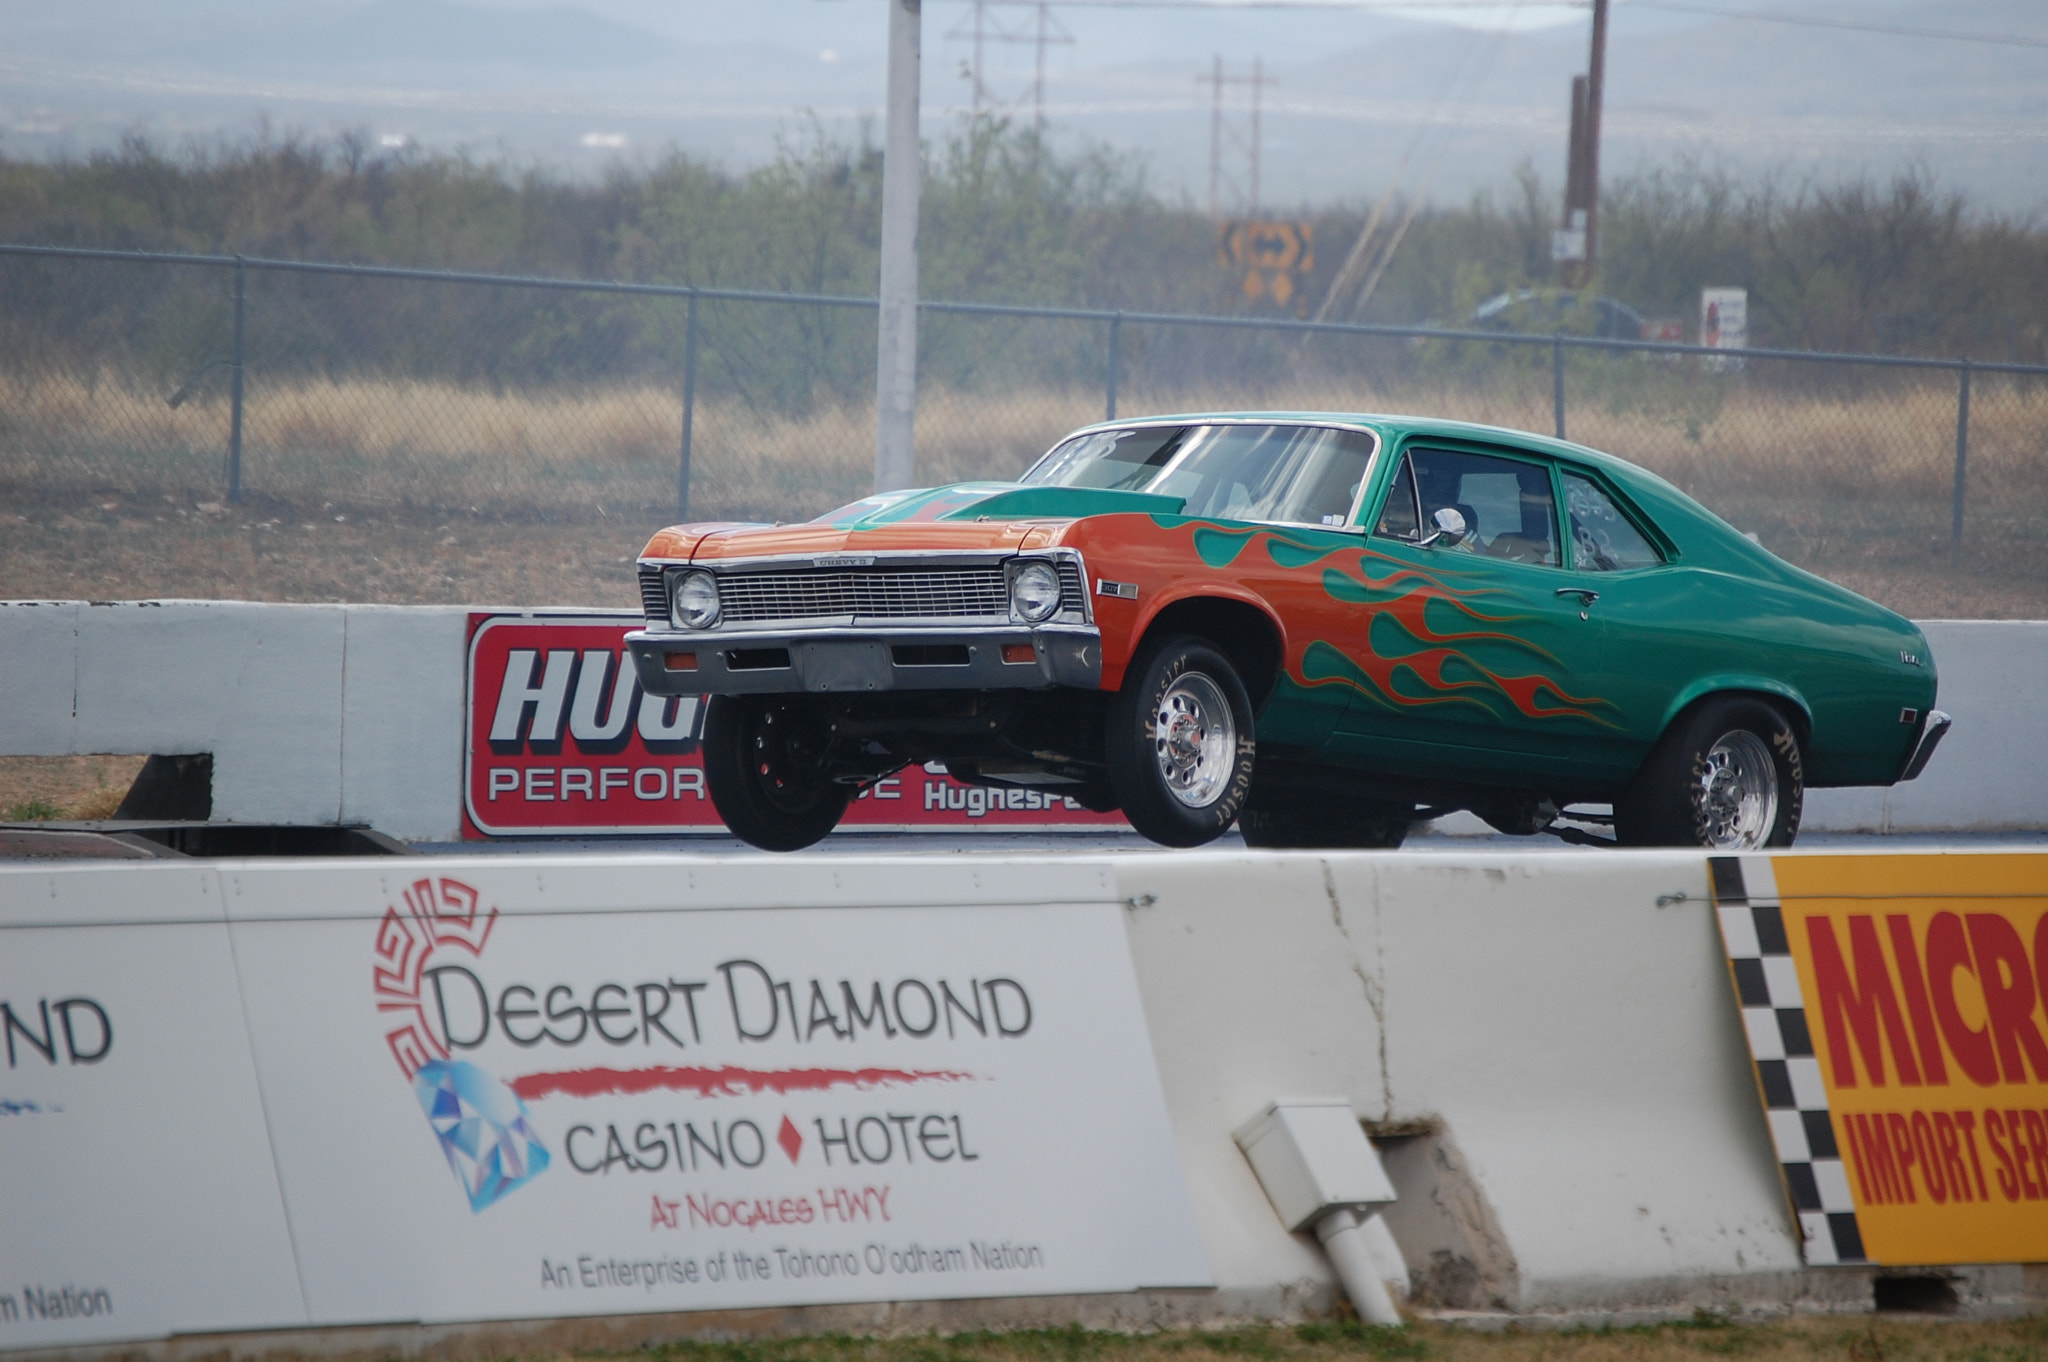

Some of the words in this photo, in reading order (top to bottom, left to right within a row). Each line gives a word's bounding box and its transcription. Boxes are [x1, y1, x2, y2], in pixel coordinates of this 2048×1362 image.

[818, 559, 857, 567] CHEVY
[1145, 653, 1188, 740] Hoosier
[1214, 733, 1256, 828] Hoosier
[425, 964, 708, 1049] DESERT
[714, 958, 1034, 1043] DIAMOND
[1805, 909, 2048, 1090] MICR
[564, 1119, 767, 1175] CASINO
[812, 1112, 979, 1166] HOTEL
[1842, 1108, 1990, 1205] IMPORT
[1984, 1107, 2048, 1204] SER
[815, 1186, 892, 1222] HWY
[23, 1285, 113, 1320] Nation
[540, 1259, 570, 1290] An
[577, 1255, 699, 1293] Enterprise
[706, 1250, 729, 1281] of
[732, 1250, 771, 1281] the
[773, 1247, 859, 1278] Tohono
[864, 1241, 963, 1275] O'odham
[969, 1239, 1043, 1271] Nation
